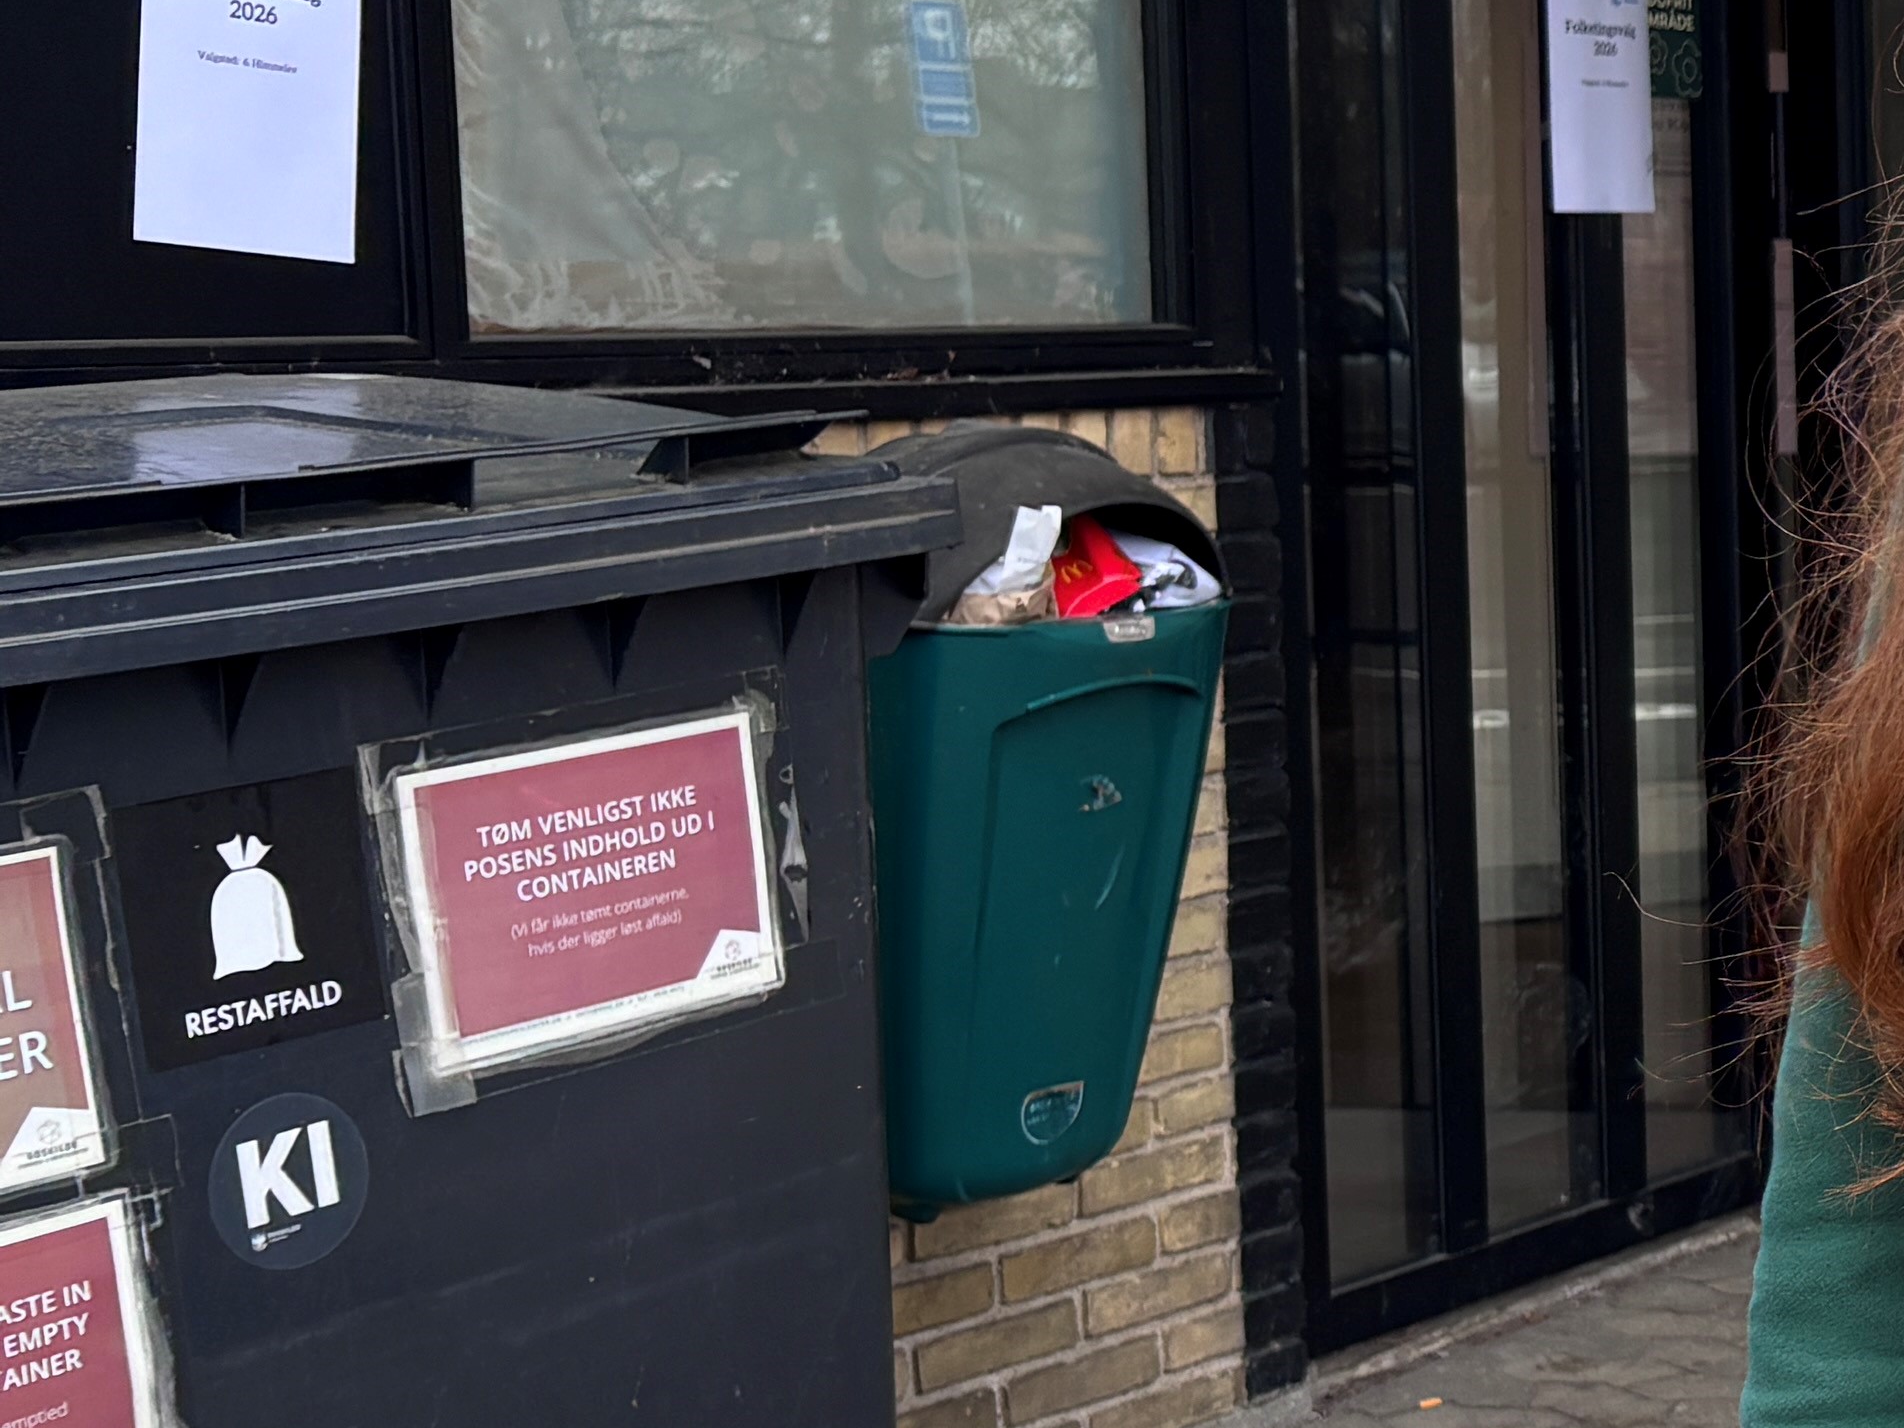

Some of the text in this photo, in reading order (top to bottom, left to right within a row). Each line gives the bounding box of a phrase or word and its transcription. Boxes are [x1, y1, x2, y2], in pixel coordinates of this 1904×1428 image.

[229, 0, 278, 25] 2026
[1648, 8, 1696, 32] MRÅDE
[476, 785, 697, 848] TØM VENLIGST IKKE
[464, 810, 715, 882] POSENS INDHOLD UD I
[516, 848, 676, 902] CONTAINEREN
[557, 934, 580, 952] der
[0, 970, 33, 1014] L
[184, 980, 343, 1039] RESTAFFALD
[235, 1119, 341, 1230] KI
[63, 1280, 92, 1307] IN
[3, 1312, 89, 1358] EMPTY
[0, 1349, 83, 1391] AINER
